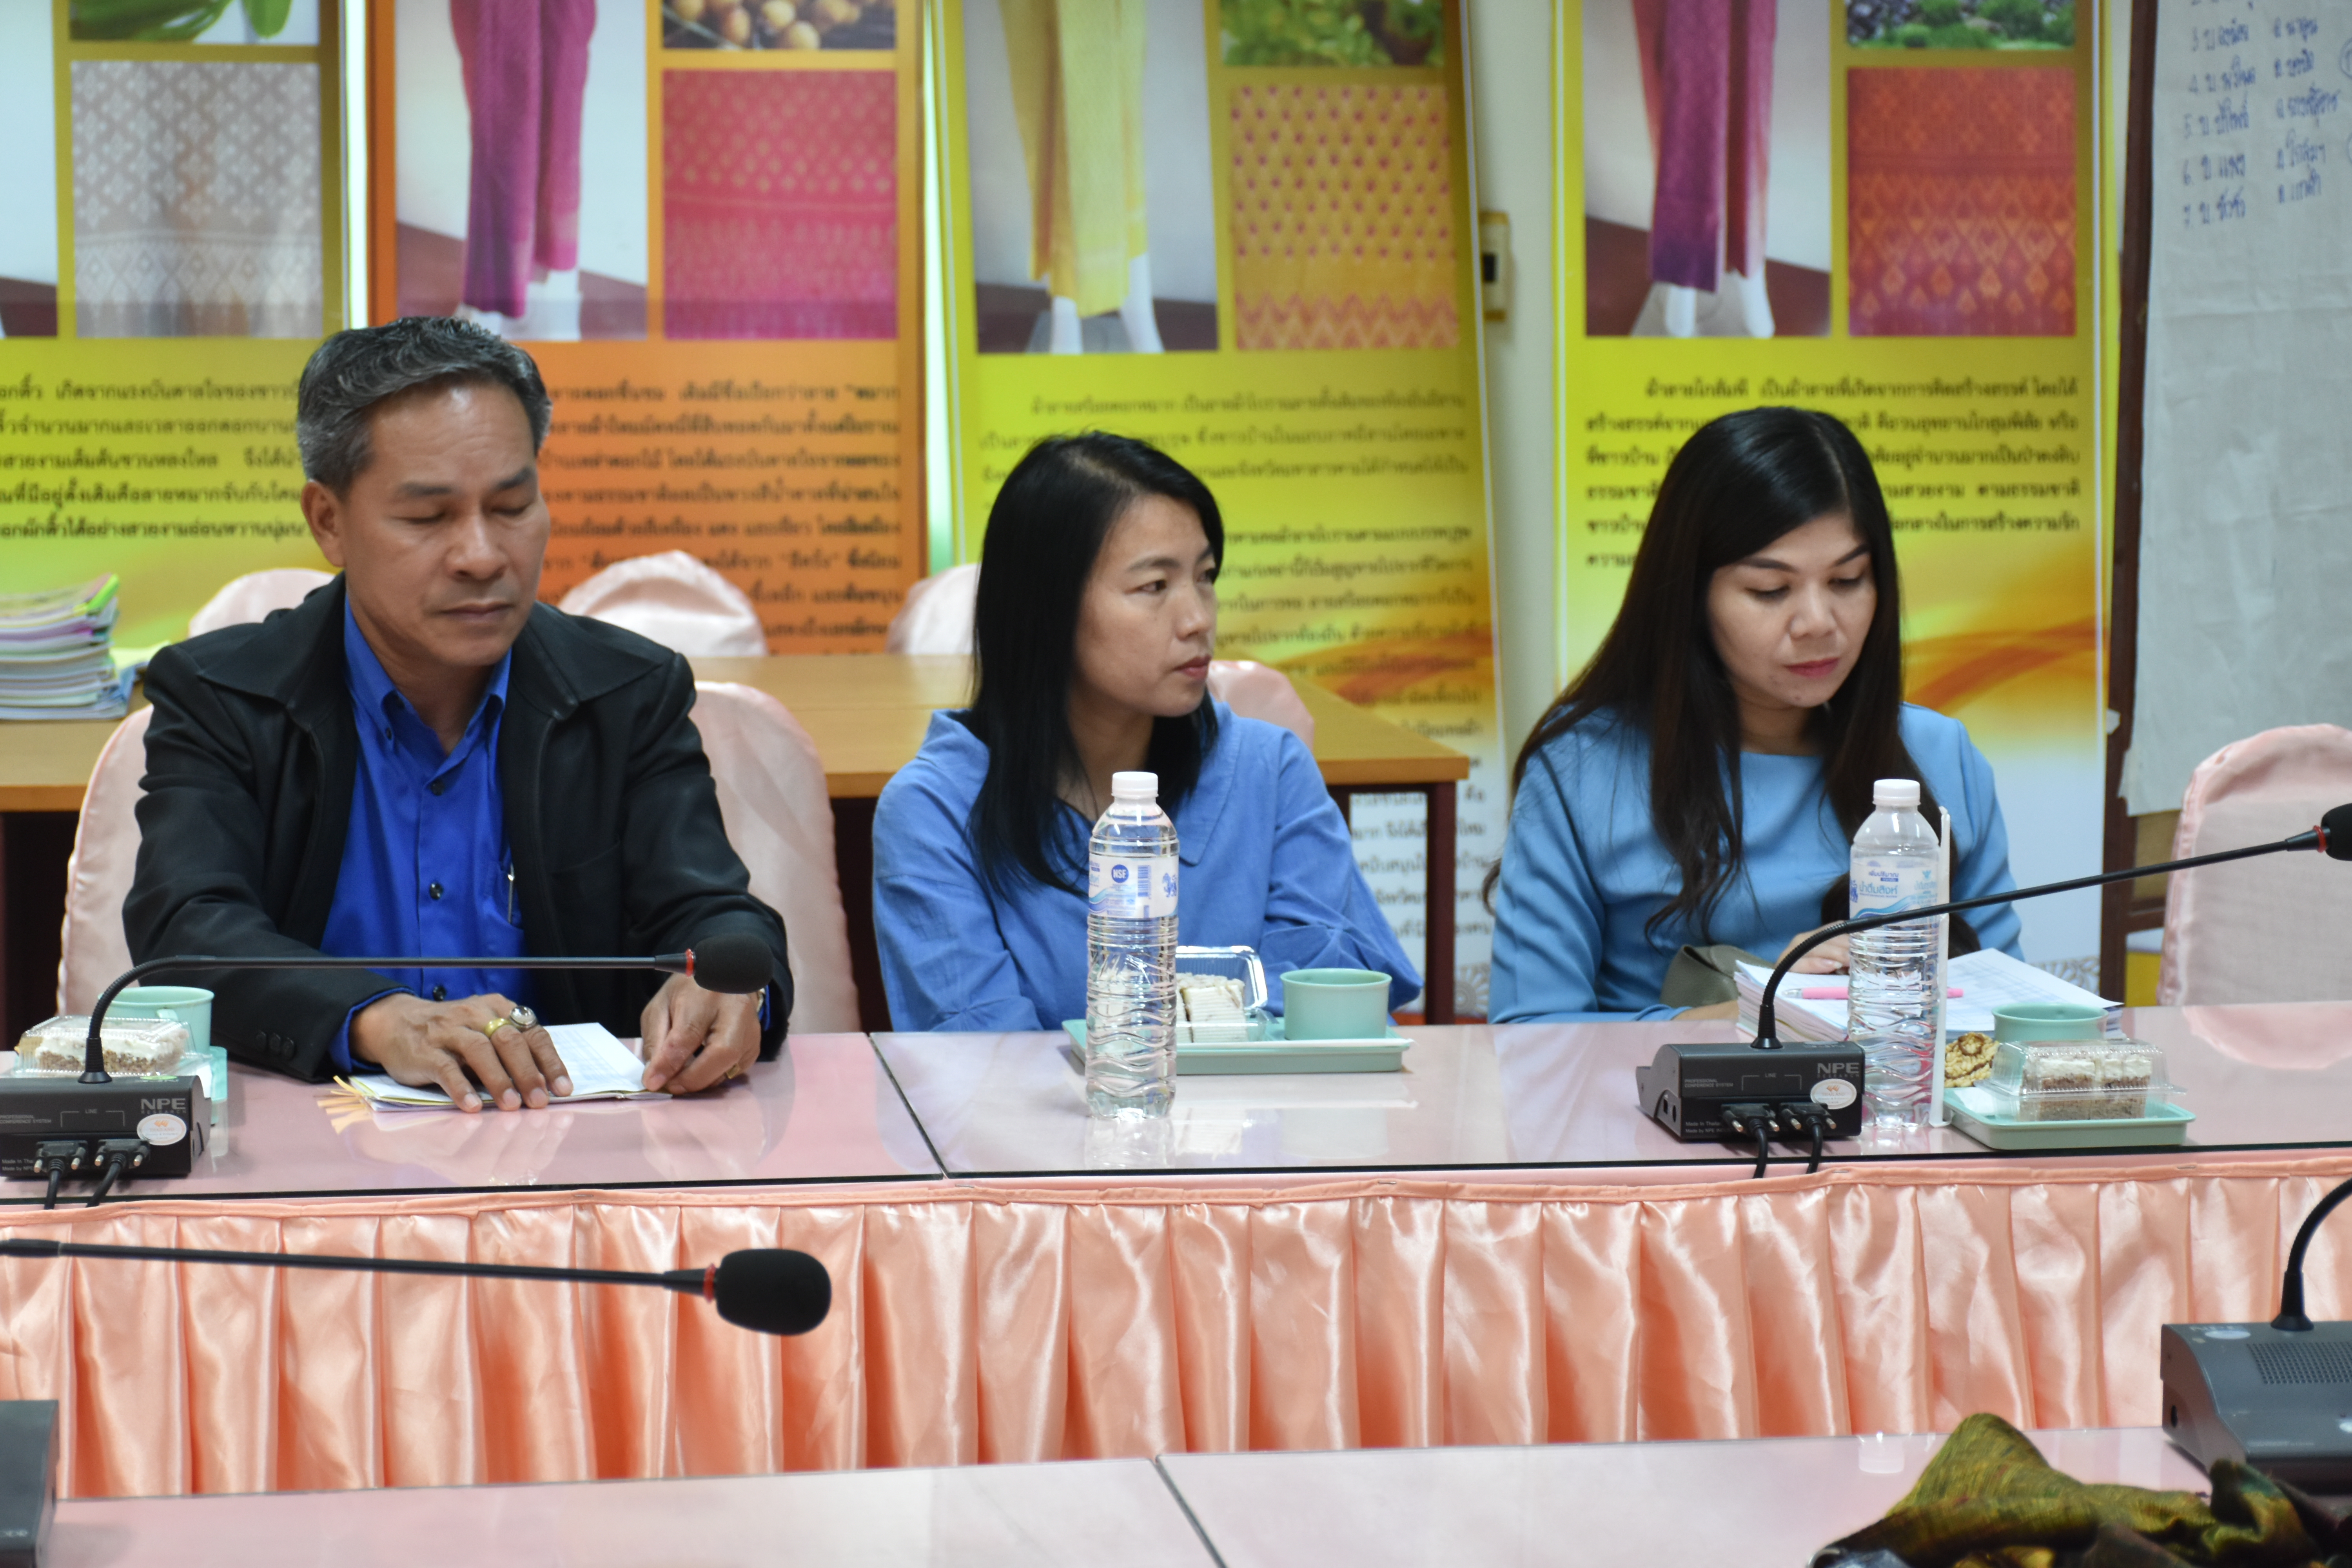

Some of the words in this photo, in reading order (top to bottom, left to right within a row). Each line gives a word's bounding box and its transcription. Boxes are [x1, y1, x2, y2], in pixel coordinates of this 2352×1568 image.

[1113, 869, 1127, 878] NSF
[1859, 882, 1898, 894] น้ำดื่มสิงห์
[1818, 1063, 1859, 1074] NPE
[141, 1098, 186, 1110] NPE
